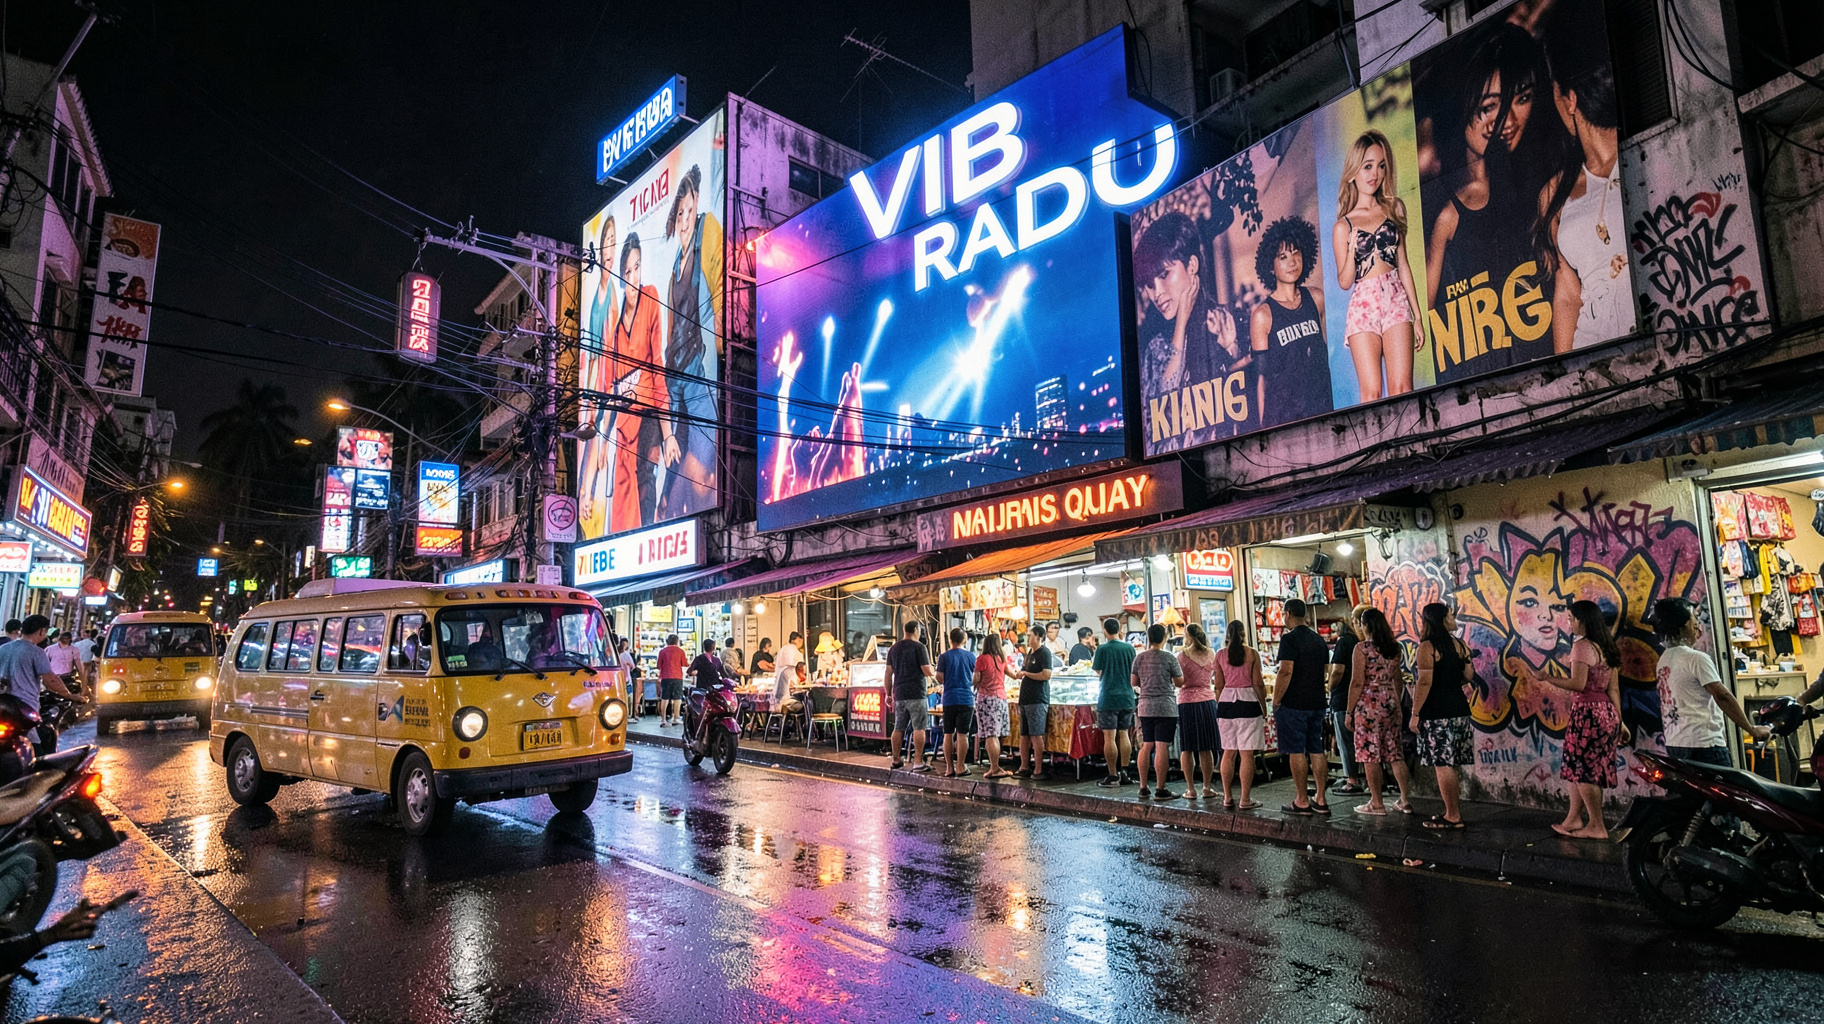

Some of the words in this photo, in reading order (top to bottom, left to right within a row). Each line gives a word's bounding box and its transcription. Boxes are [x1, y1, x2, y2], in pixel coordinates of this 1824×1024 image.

[849, 101, 1027, 241] VIB
[913, 122, 1179, 294] RADU
[1064, 474, 1148, 521] QUAY
